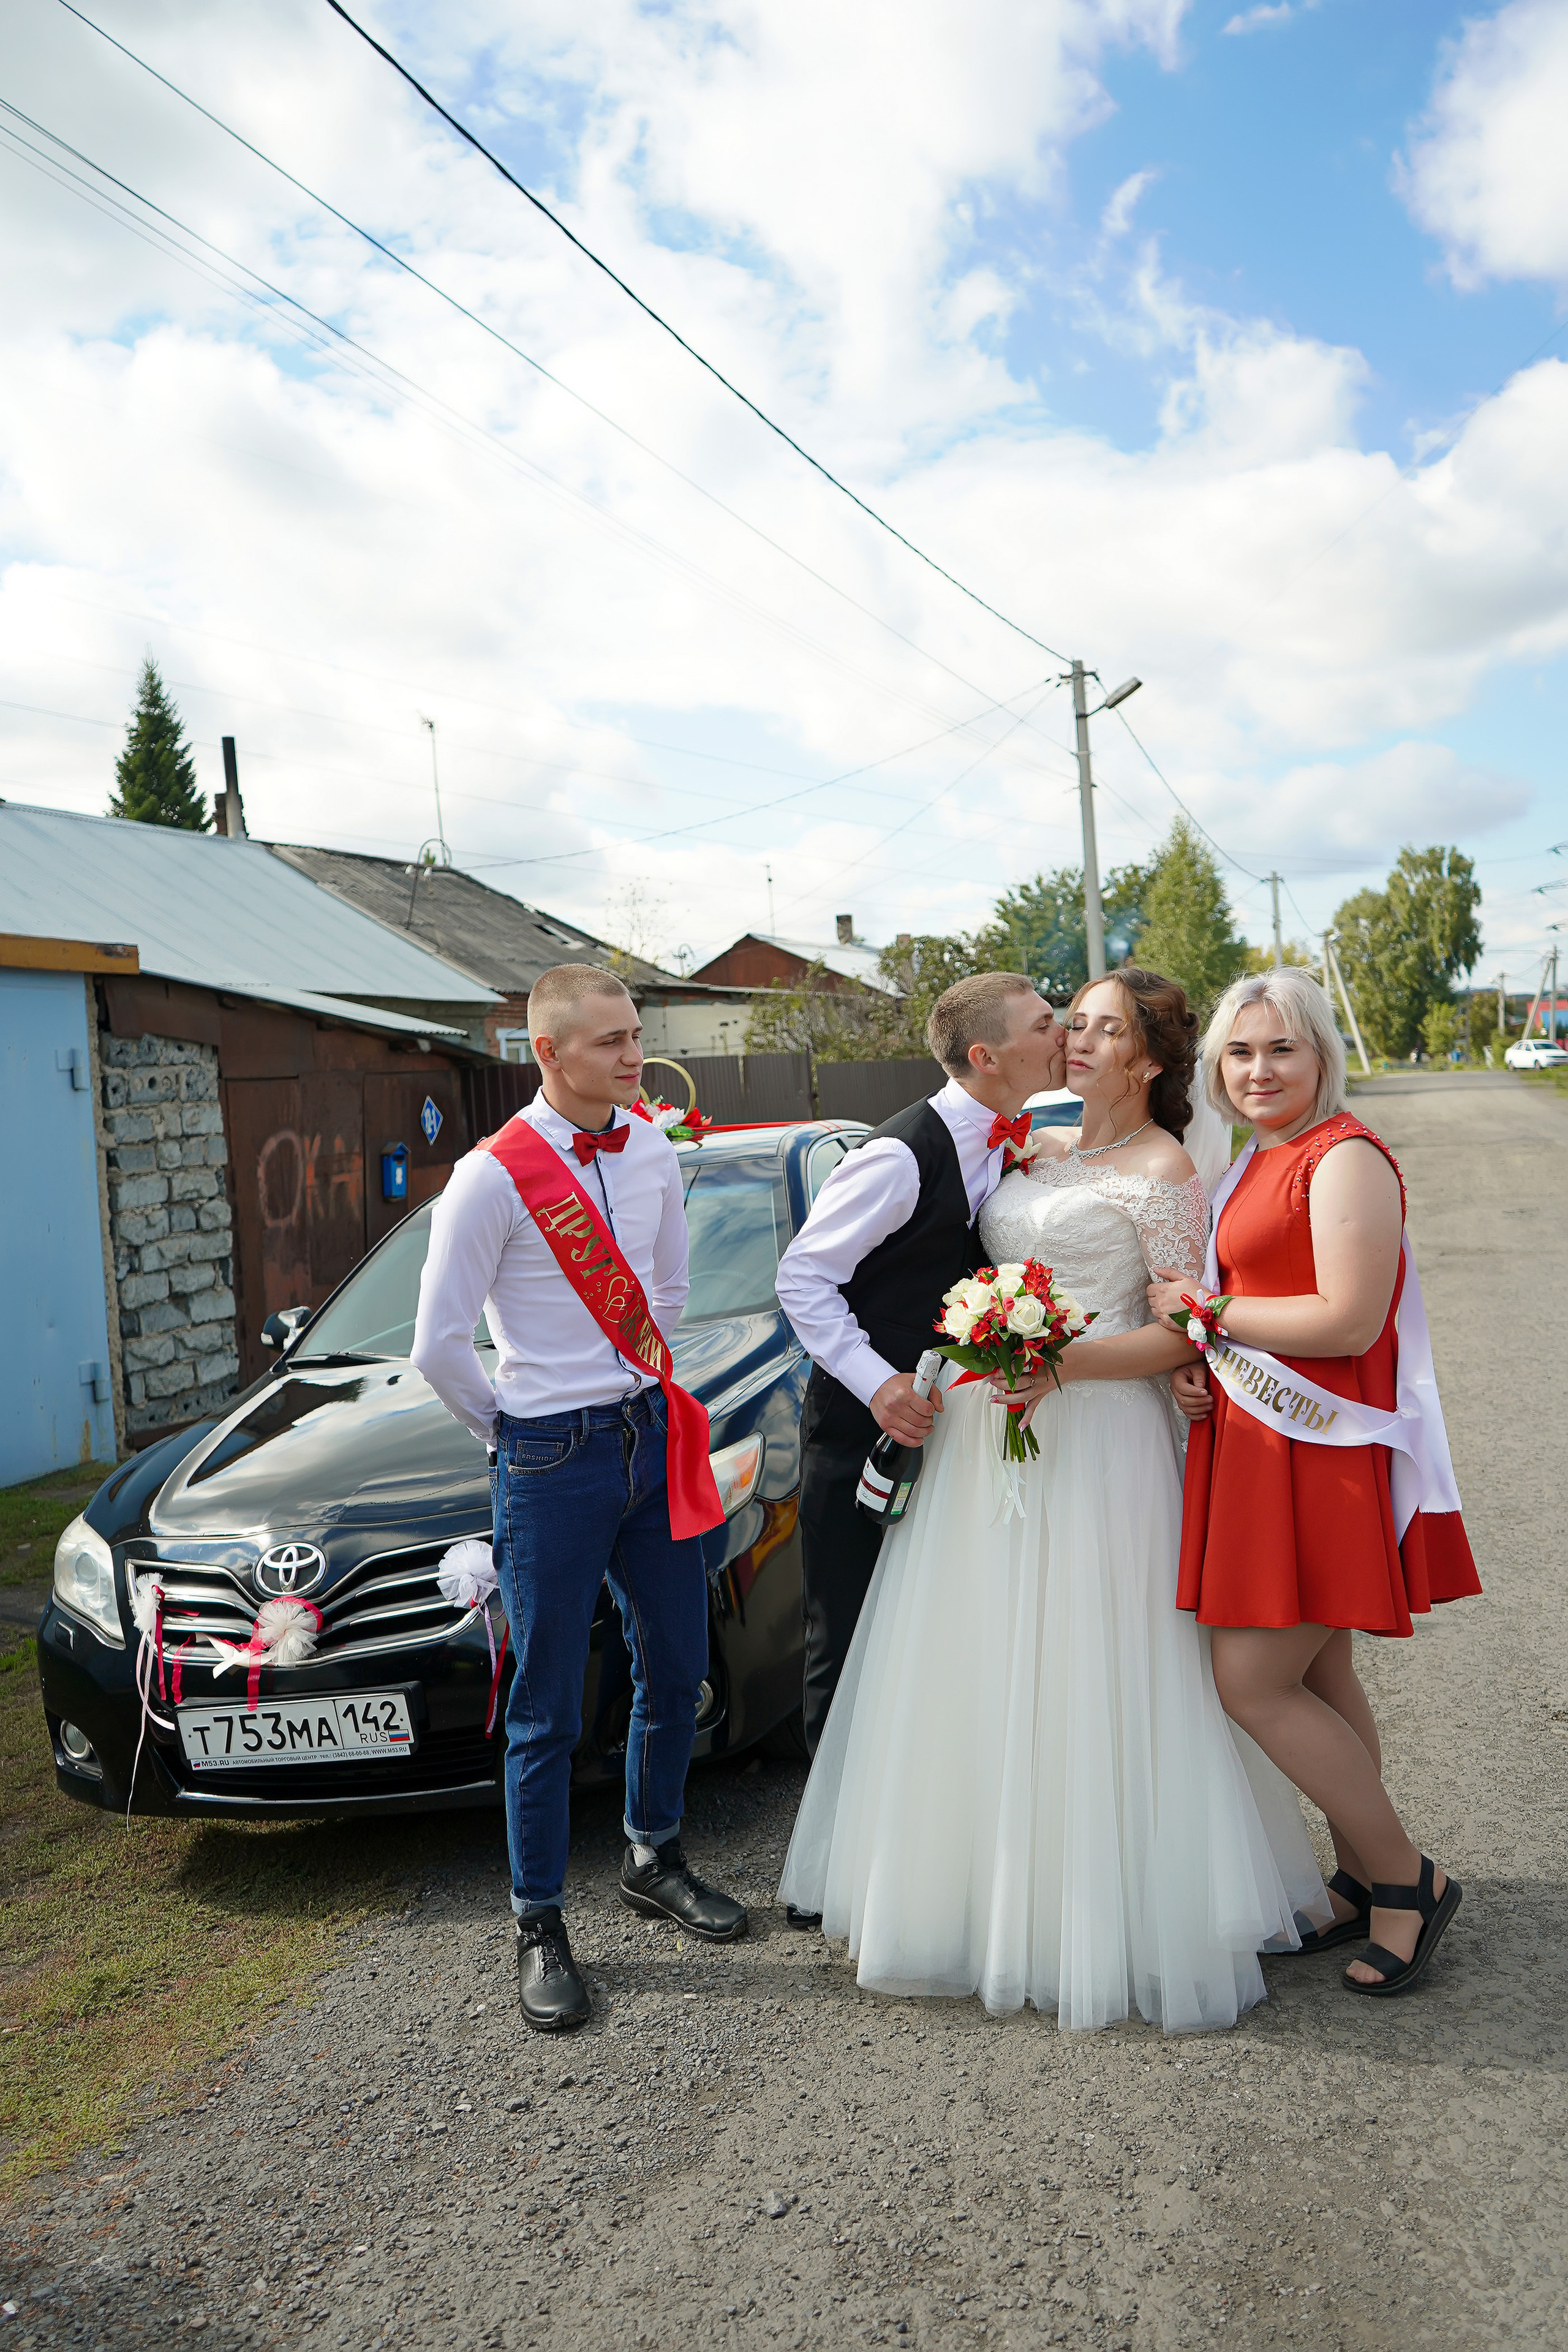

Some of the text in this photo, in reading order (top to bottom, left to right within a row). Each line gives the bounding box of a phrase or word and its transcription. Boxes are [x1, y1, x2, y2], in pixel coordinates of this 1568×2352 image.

[535, 1191, 666, 1376] ДРУГ ЖЕНИ
[1213, 1346, 1340, 1436] НЕВЕСТЫ
[192, 1699, 401, 1755] Т753МА 142
[360, 1730, 388, 1744] RUS
[232, 1756, 275, 1765] АВТОМОБИЛЬНЫЙ
